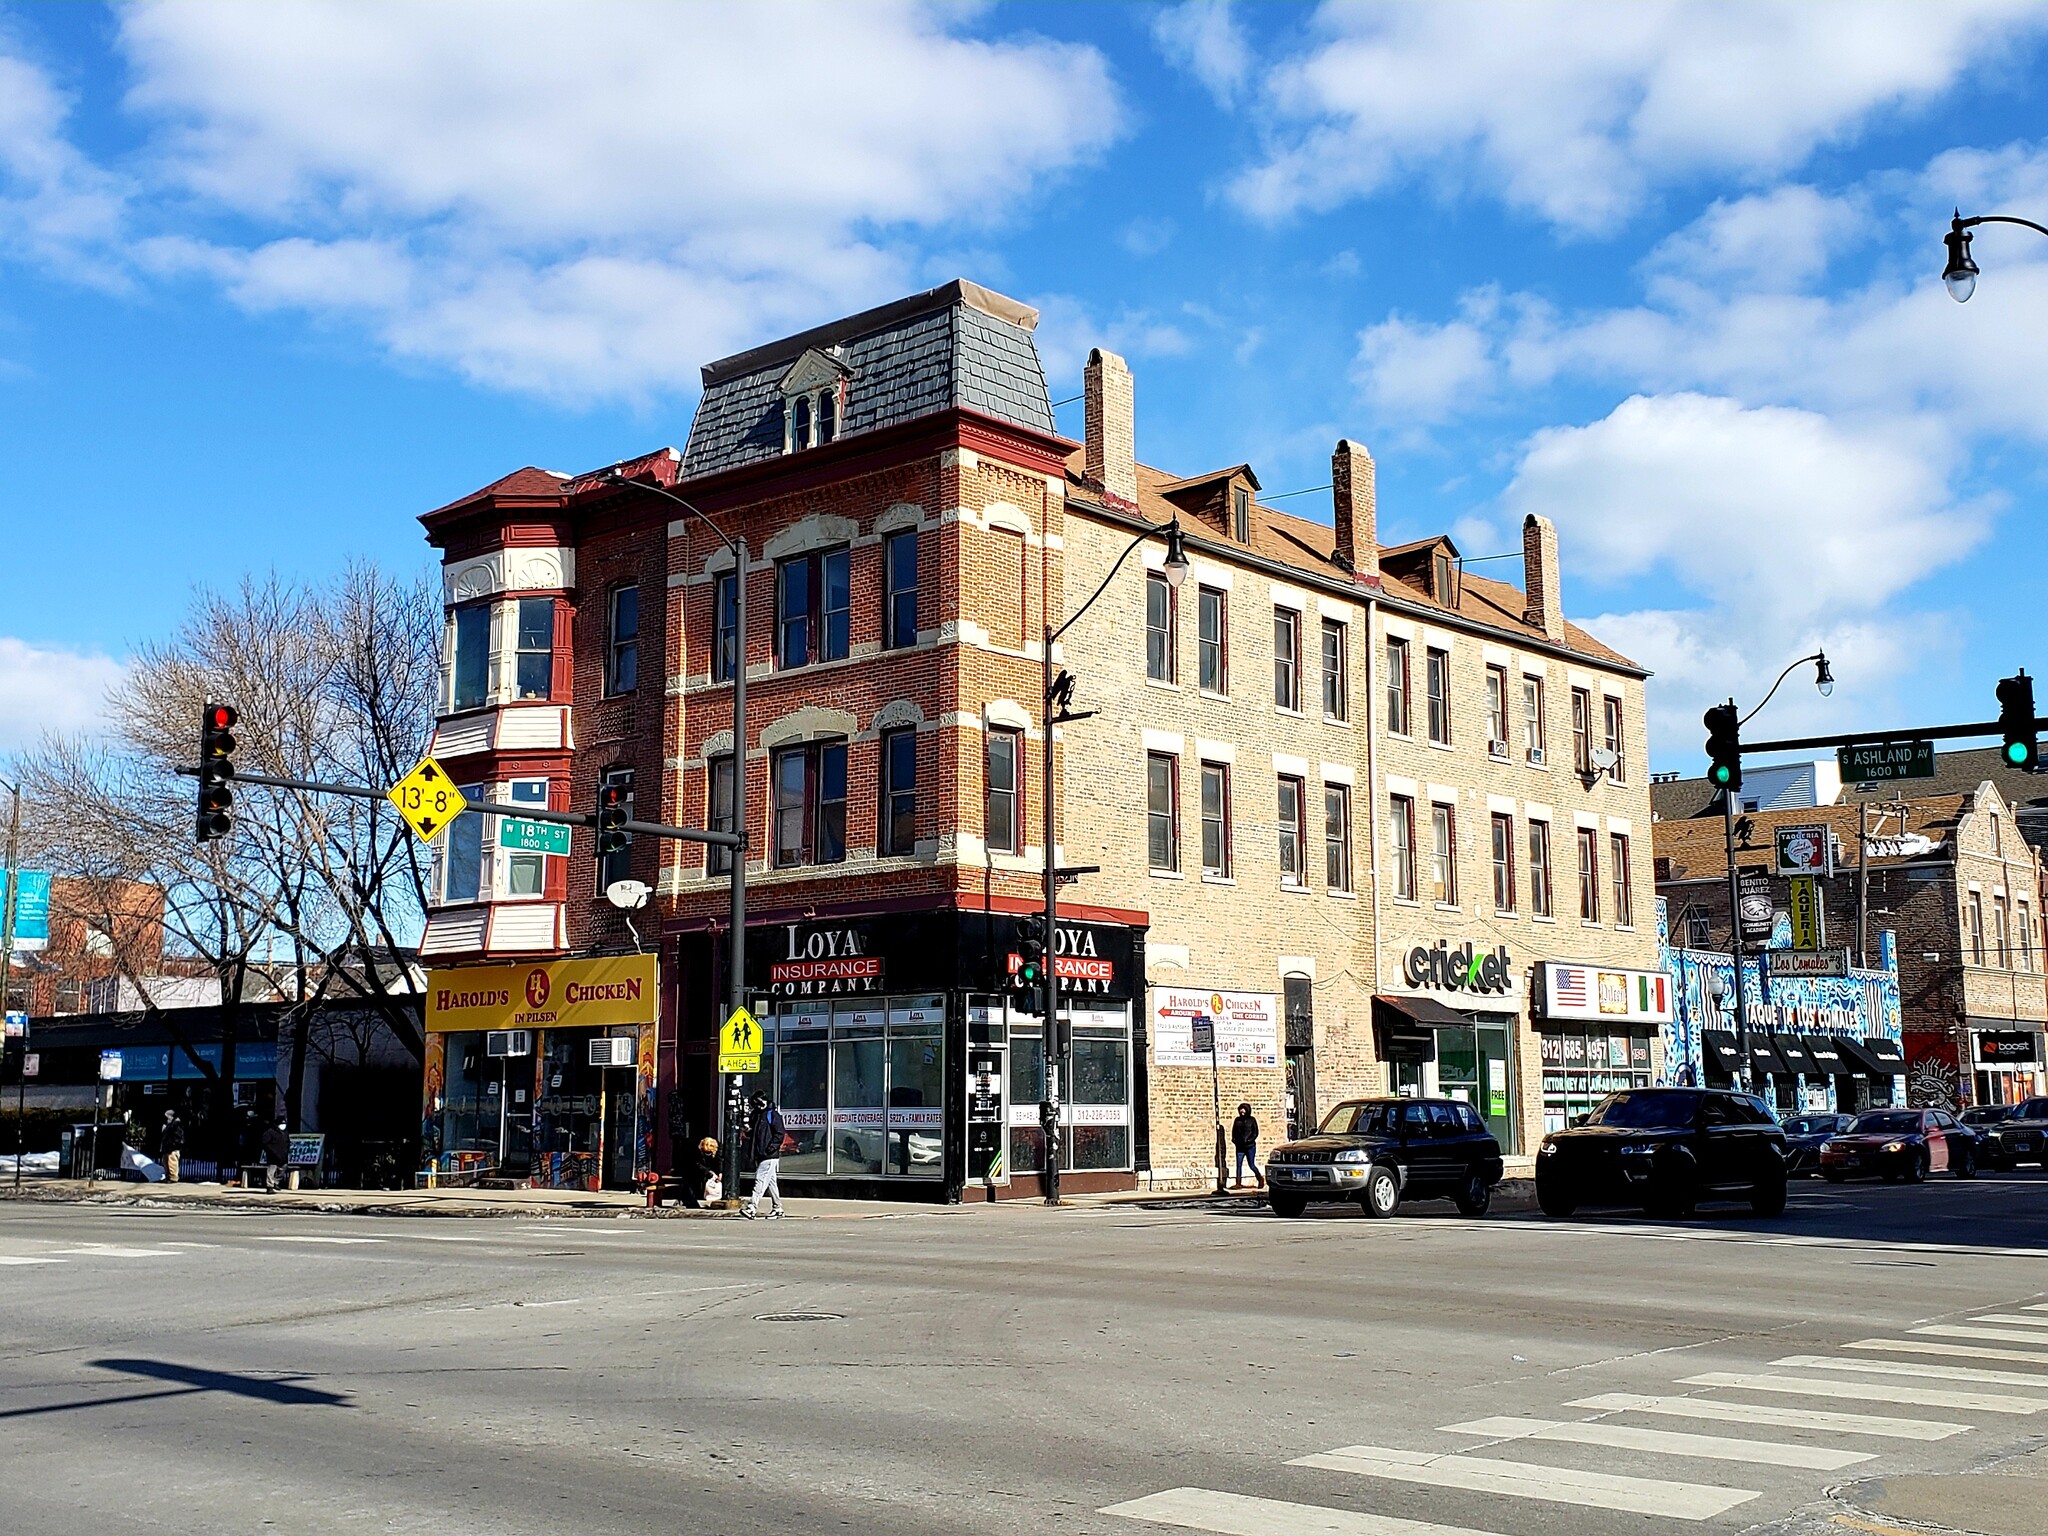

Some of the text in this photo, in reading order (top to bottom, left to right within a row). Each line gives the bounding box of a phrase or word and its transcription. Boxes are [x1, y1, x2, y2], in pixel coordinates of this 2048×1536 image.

[1843, 748, 1929, 765] S ASHLAND AV
[1866, 765, 1907, 777] 1600 W
[401, 786, 455, 813] 13'-8"
[506, 824, 566, 840] W 18TH ST
[1781, 832, 1819, 840] TAQUERIA
[520, 838, 550, 850] 1800 S
[1740, 878, 1769, 887] BENITO
[1740, 886, 1771, 895] JUÁREZ
[1797, 880, 1812, 946] TAQUERIA
[786, 925, 860, 960] LOYA
[1042, 927, 1098, 957] OYA
[773, 959, 878, 979] INSURANCE
[1406, 939, 1512, 990] cricket
[1774, 953, 1841, 971] Los Comales #3
[771, 977, 873, 996] COMPANY
[1014, 976, 1112, 993] CPANY
[436, 977, 643, 1011] HAROLD'S CHICKEN
[1169, 995, 1209, 1007] HAROLD'S
[1225, 999, 1261, 1011] CHICKEN
[514, 1011, 557, 1023] IN PILSEN
[1797, 1006, 1815, 1028] LOS
[1818, 1008, 1859, 1029] COMALES
[1998, 1041, 2029, 1050] boost
[1578, 1077, 1587, 1091] AT
[1491, 1090, 1505, 1100] FREE
[783, 1114, 827, 1125] 12-226-0358
[858, 1113, 883, 1123] COVERAGE
[908, 1113, 925, 1123] FAMILY
[926, 1113, 942, 1122] RATES
